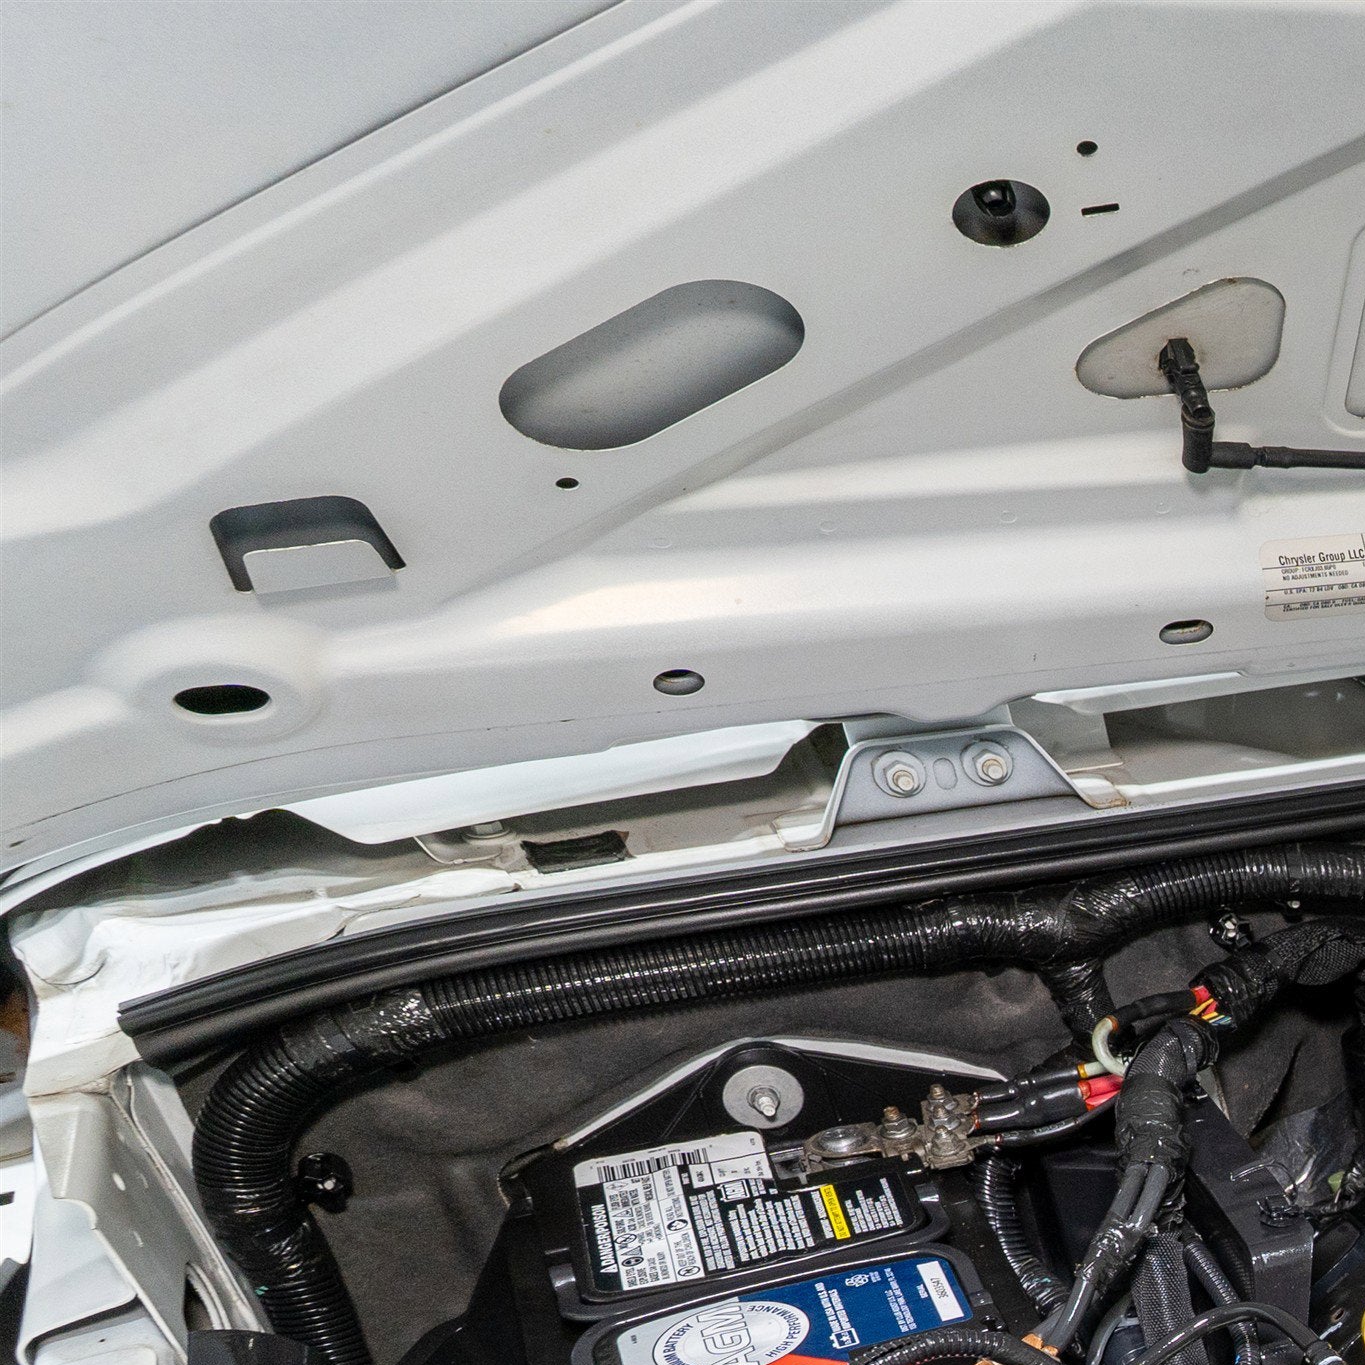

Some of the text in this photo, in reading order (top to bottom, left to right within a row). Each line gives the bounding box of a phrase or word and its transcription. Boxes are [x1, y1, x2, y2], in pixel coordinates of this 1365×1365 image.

[1278, 548, 1364, 567] Chrysler Group LLC
[590, 1203, 615, 1266] DANGER/POISON
[663, 1323, 694, 1356] BATTERY
[747, 1305, 801, 1342] PERFORMANCE
[766, 1338, 792, 1358] HIGH
